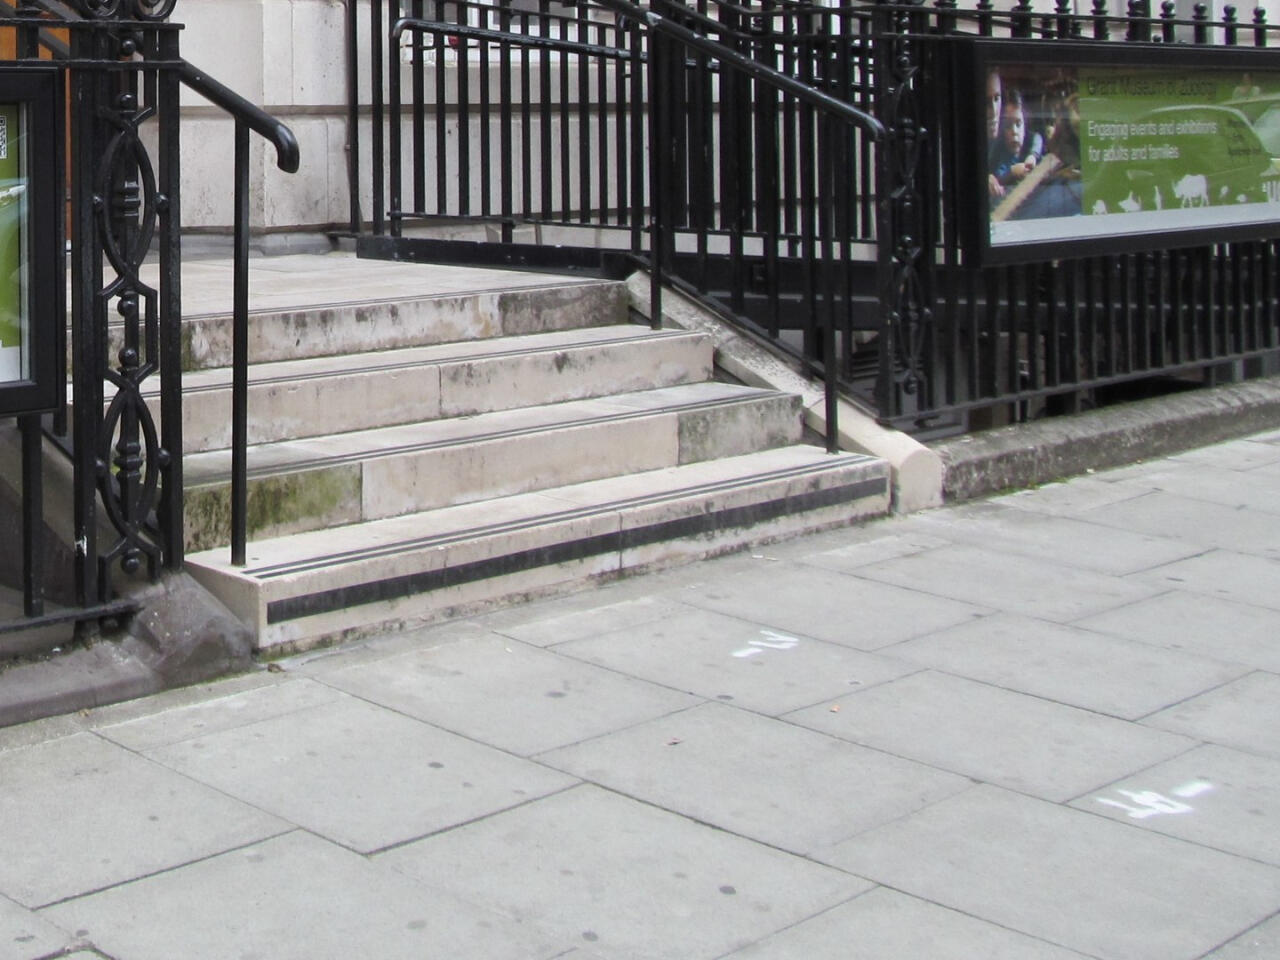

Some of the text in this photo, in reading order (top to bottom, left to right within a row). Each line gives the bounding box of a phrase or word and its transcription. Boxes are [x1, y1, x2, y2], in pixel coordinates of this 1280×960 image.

[1087, 120, 1128, 140] Engaging
[1130, 121, 1157, 136] events
[1159, 120, 1175, 135] and
[1176, 119, 1217, 135] exhibitions
[1088, 144, 1179, 161] for adults and families
